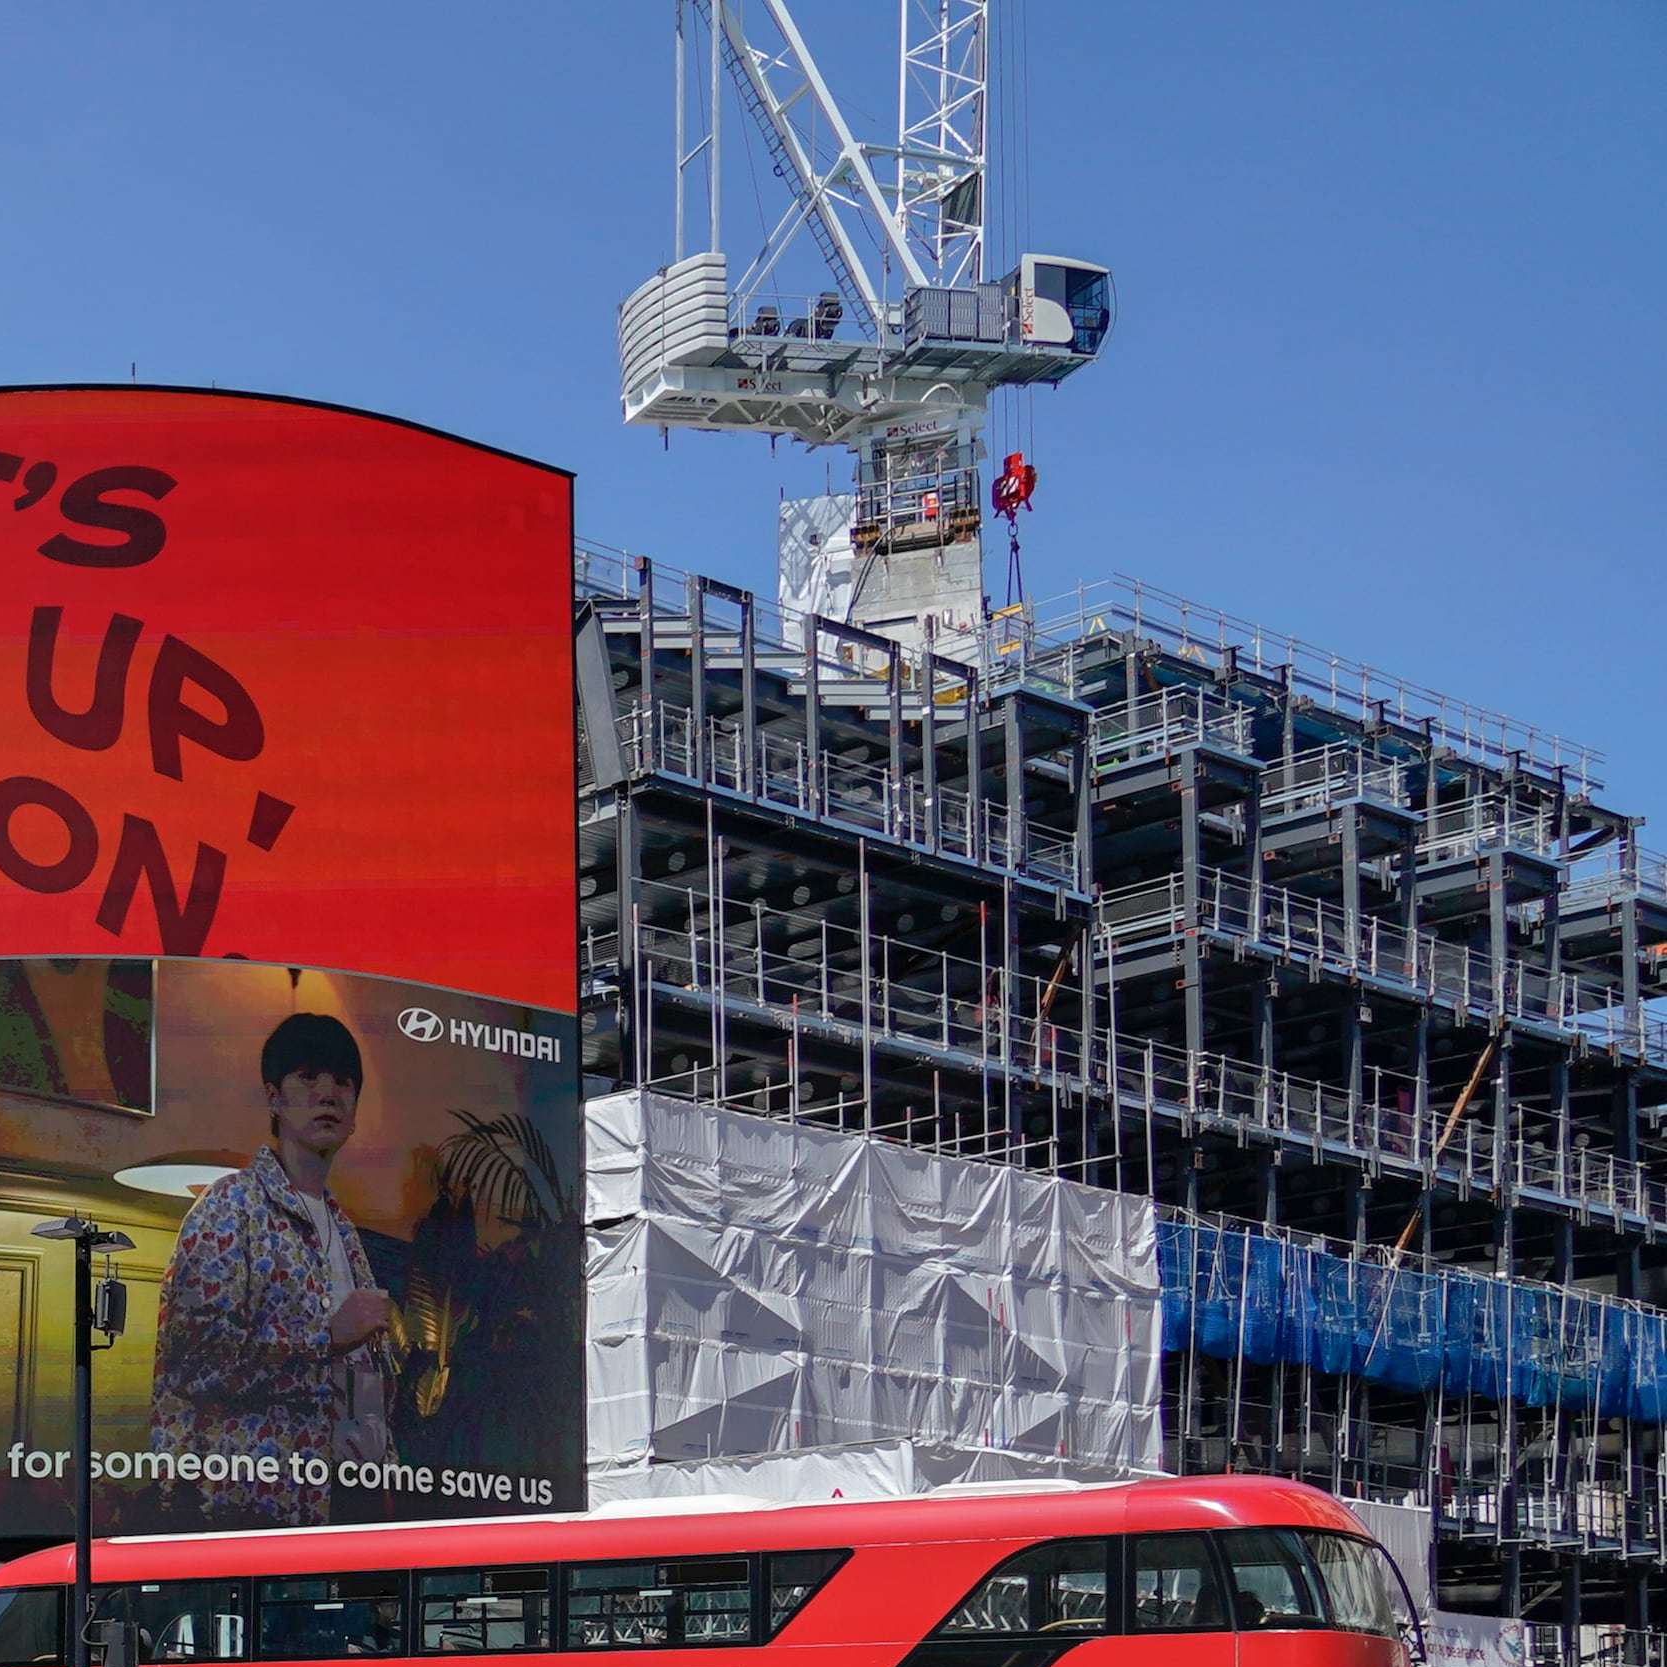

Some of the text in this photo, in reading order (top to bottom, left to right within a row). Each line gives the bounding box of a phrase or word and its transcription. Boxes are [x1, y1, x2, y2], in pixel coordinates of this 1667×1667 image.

[1023, 287, 1034, 322] Select
[749, 379, 782, 391] Sect
[899, 420, 938, 436] Select
[448, 1020, 562, 1064] HYUNDAI
[7, 1442, 553, 1506] for someone to come save us
